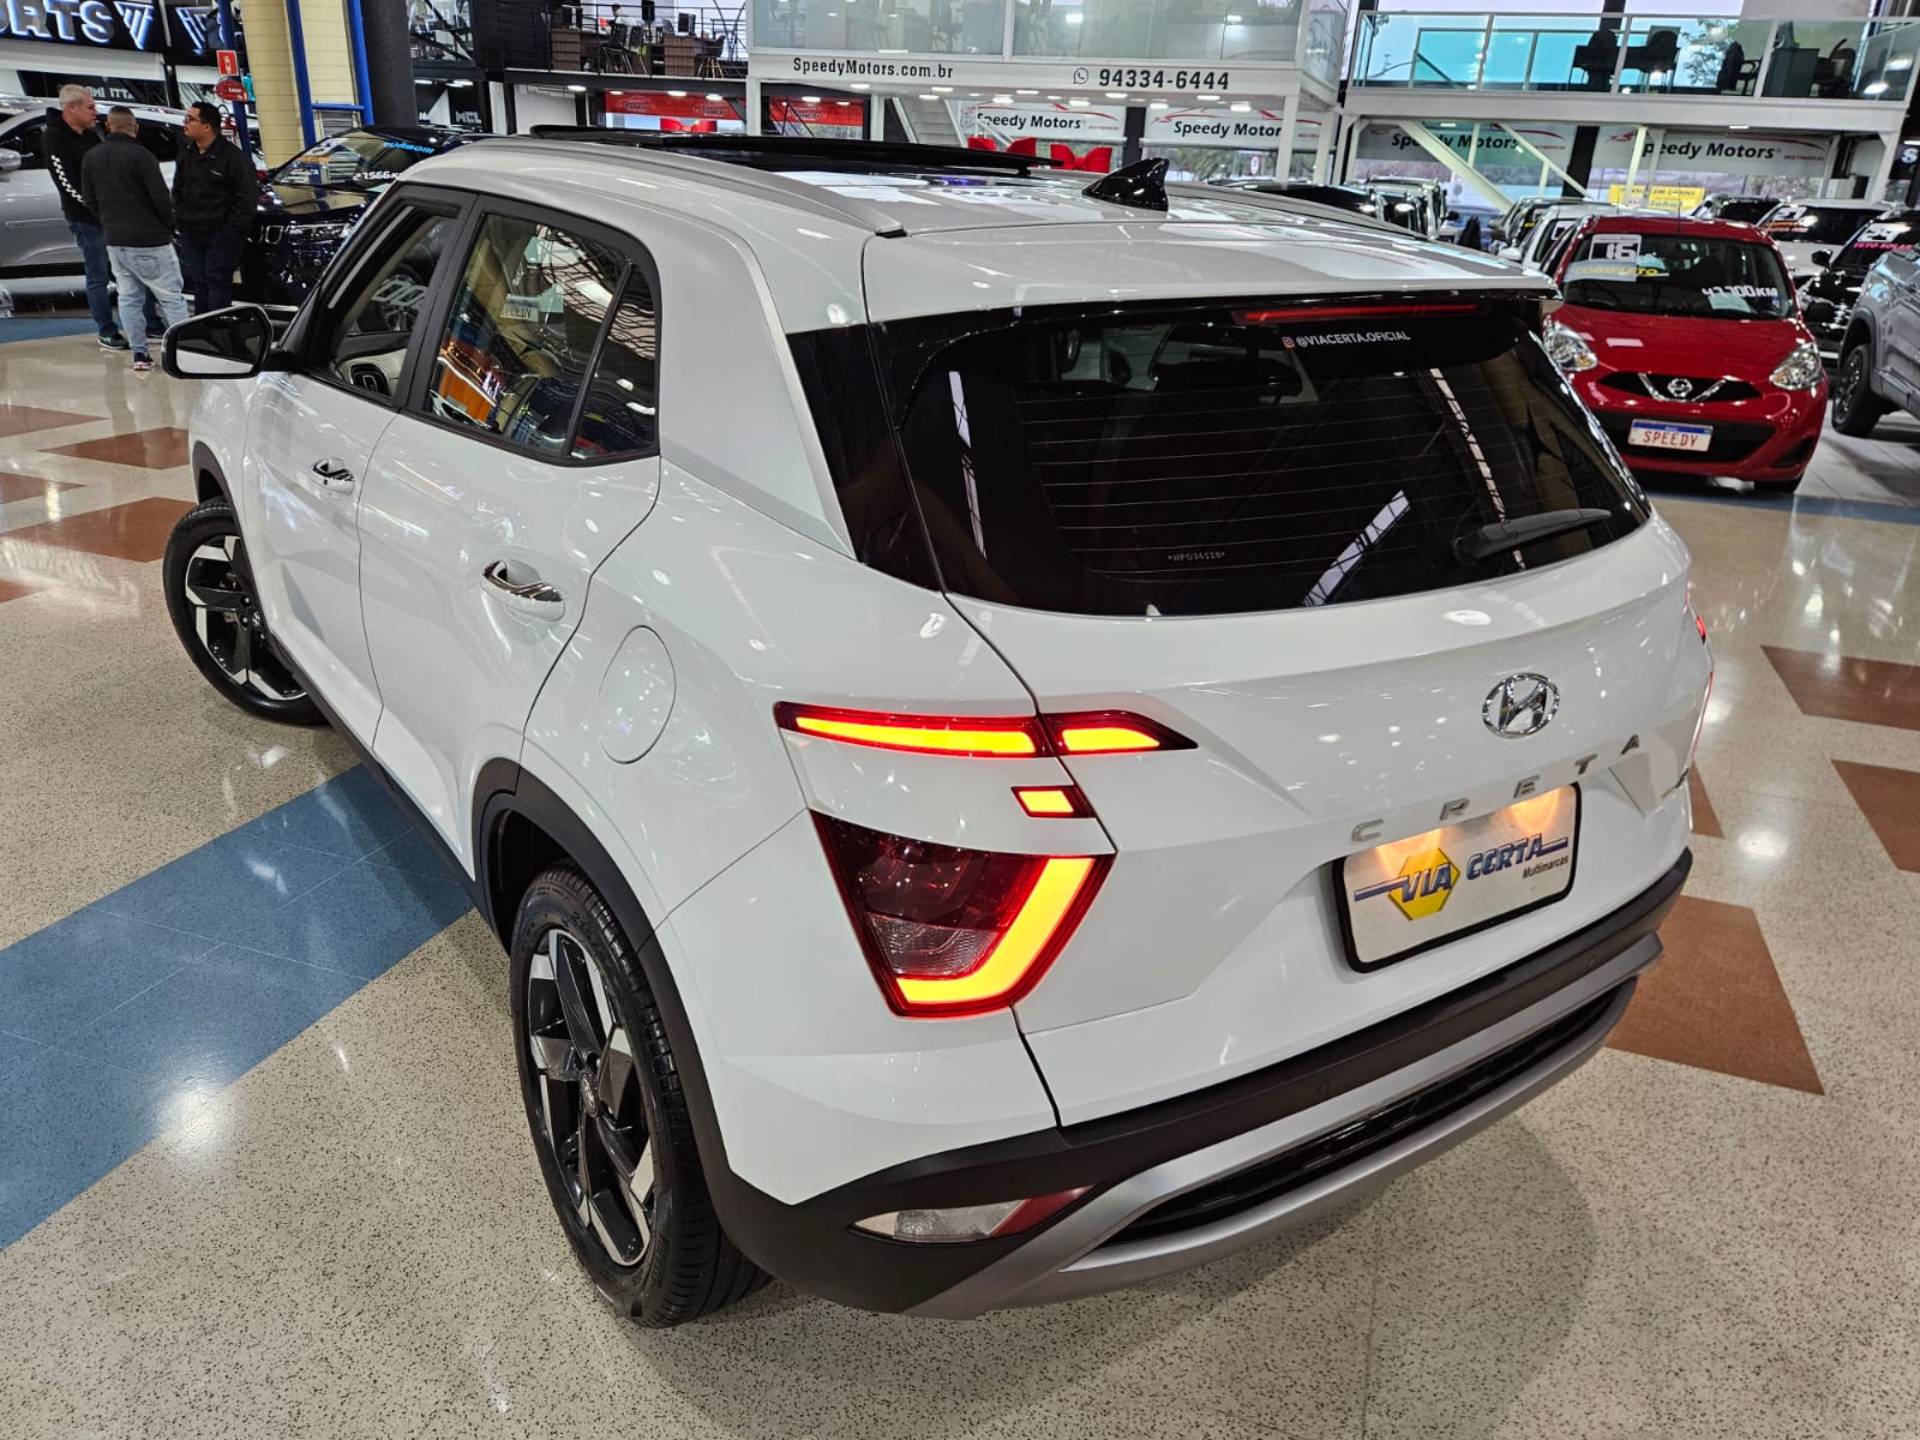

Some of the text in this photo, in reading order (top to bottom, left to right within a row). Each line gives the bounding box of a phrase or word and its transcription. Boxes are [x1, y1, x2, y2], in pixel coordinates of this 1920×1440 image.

[0, 0, 114, 43] RTS
[793, 57, 954, 78] SpeedyMotors.com.br
[1099, 68, 1230, 90] 94334-6444
[1030, 114, 1082, 129] Motors
[1173, 120, 1283, 139] Speedy Motor
[1705, 141, 1777, 160] Motors
[1296, 331, 1411, 347] @VIACERTA.OFICIAL
[1643, 430, 1698, 448] SPEEDY
[1351, 734, 1640, 843] CRETA
[1392, 833, 1568, 903] VIA CERTA
[1522, 856, 1569, 878] Multimarcas
